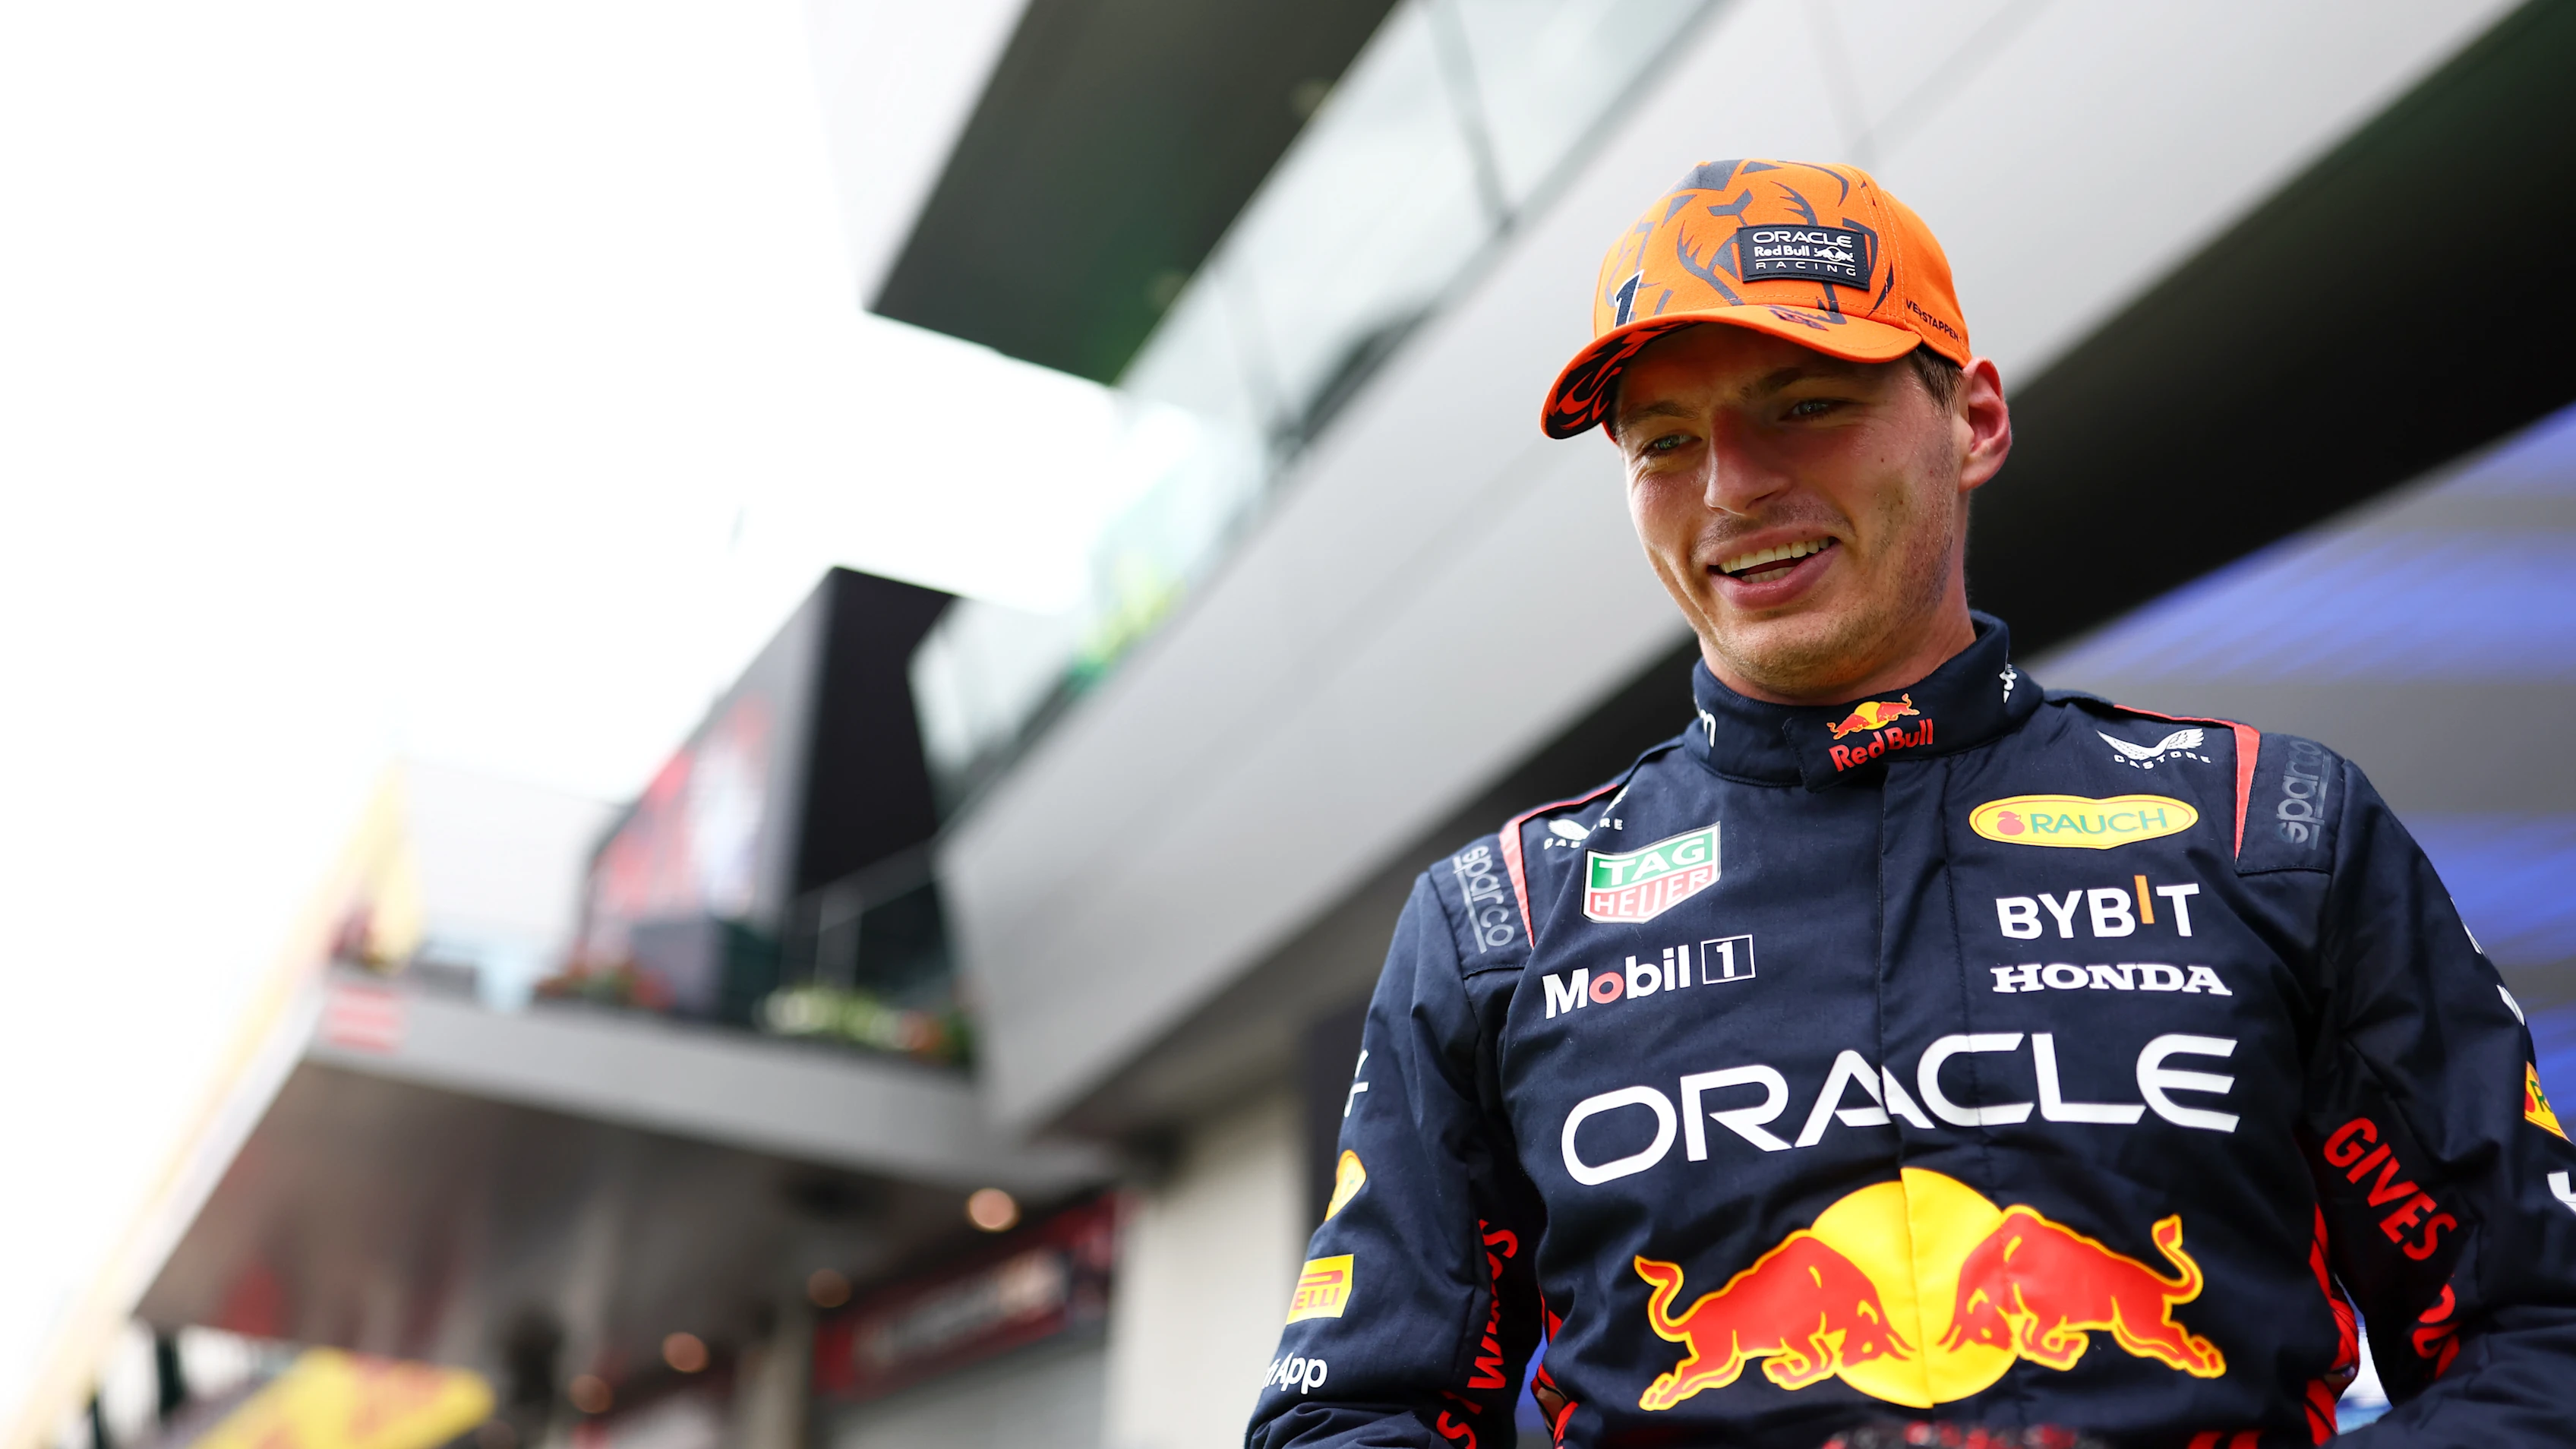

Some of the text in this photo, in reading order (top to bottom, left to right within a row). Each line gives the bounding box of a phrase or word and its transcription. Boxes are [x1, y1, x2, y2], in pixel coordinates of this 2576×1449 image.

[1753, 231, 1852, 248] ORACLE
[1756, 261, 1856, 276] RACING
[1613, 269, 1645, 330] 1
[1905, 298, 1959, 343] VERSTAPPEN
[2114, 750, 2211, 769] CASTORE
[2275, 740, 2325, 844] sparco
[2029, 807, 2168, 835] RAUCH
[1599, 838, 1706, 886] TAG
[1453, 844, 1515, 948] sparco
[1594, 869, 1708, 917] HEUER
[1995, 875, 2200, 940] BYBIT
[1542, 945, 1691, 1019] Mobil
[1990, 962, 2233, 996] HONDA
[1561, 1032, 2240, 1186] ORACLE
[2322, 1117, 2459, 1261] GIVES
